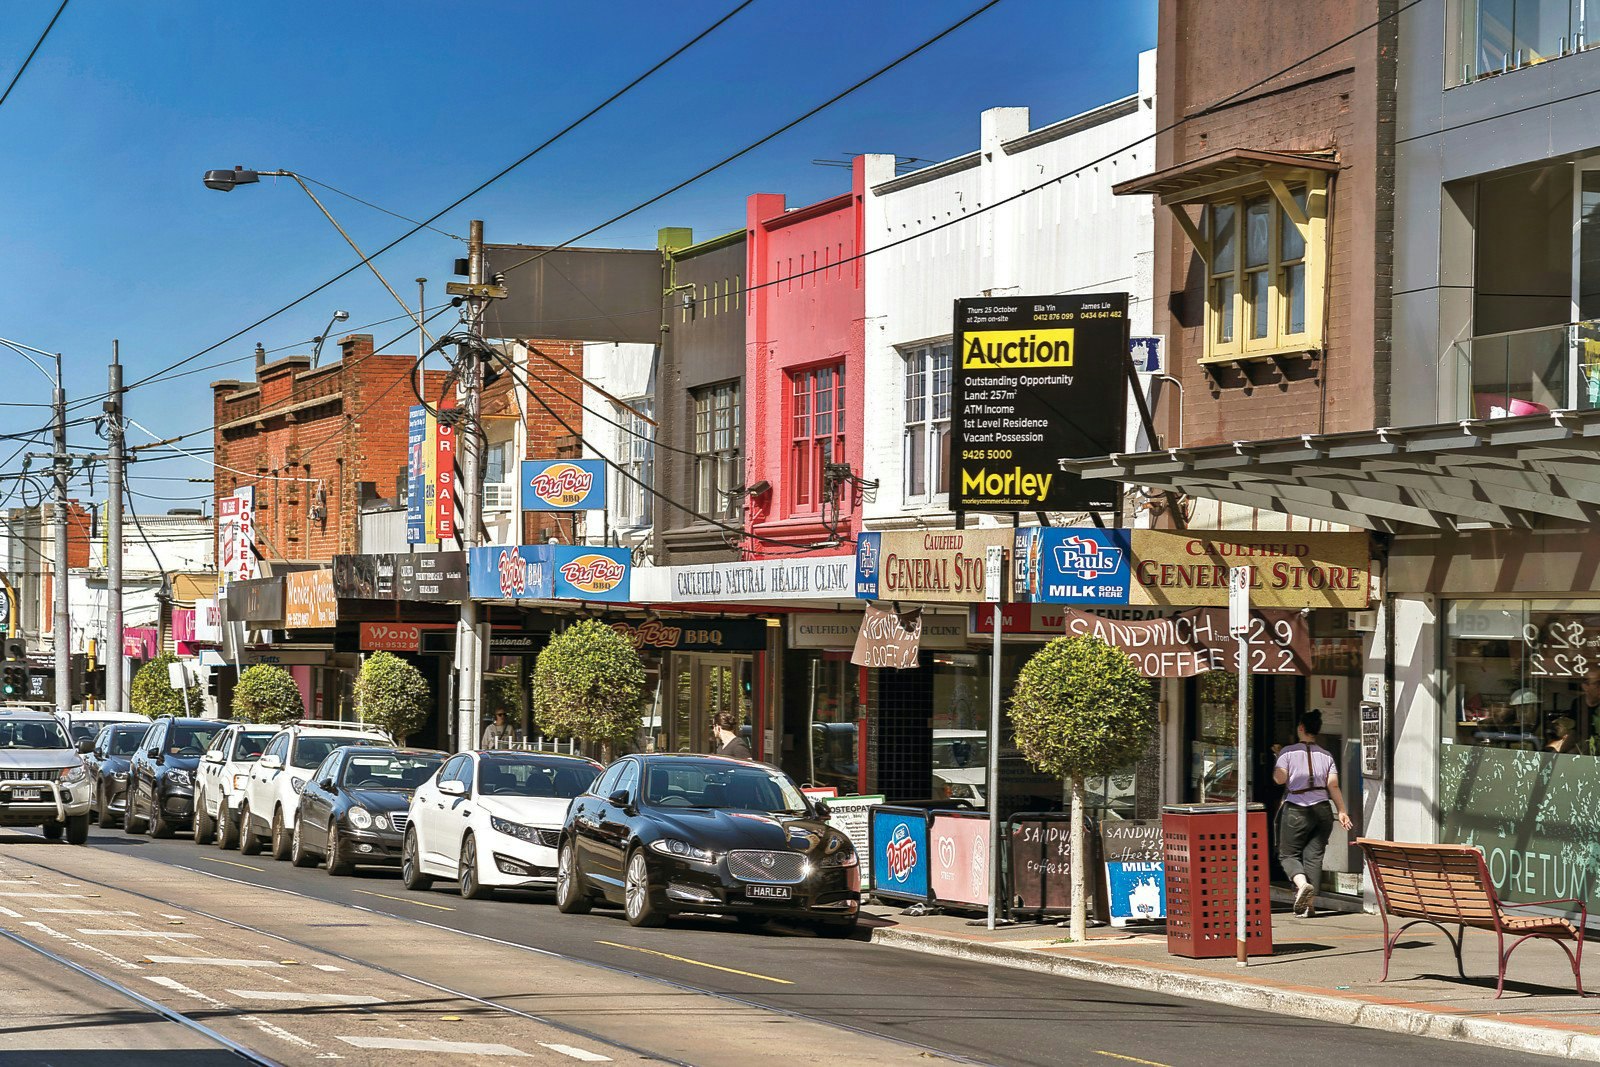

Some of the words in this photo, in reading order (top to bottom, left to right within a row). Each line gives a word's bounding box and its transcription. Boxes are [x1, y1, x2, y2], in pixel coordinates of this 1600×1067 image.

[966, 335, 1070, 364] Auction
[964, 376, 1017, 387] Outstanding
[1020, 374, 1074, 387] Opportunity
[964, 390, 988, 400] Land:
[964, 405, 982, 414] ATM
[984, 405, 1014, 414] Income
[963, 419, 975, 428] 1st
[977, 418, 1001, 428] Level
[1003, 418, 1048, 427] Residence
[963, 433, 994, 442] Vacant
[996, 432, 1044, 442] Possession
[962, 450, 985, 460] 9426
[987, 450, 1012, 459] 5000
[531, 474, 562, 500] Big
[558, 468, 593, 492] Boy
[962, 466, 1053, 502] Morley
[440, 473, 451, 531] SALE
[563, 494, 580, 503] BBQ
[241, 500, 249, 533] FOR
[924, 534, 963, 550] CAULFIELD
[1016, 536, 1027, 547] REAL
[1185, 540, 1309, 557] CAULFIELD
[1063, 550, 1113, 569] Pauls
[528, 563, 543, 588] BBQ
[560, 562, 594, 585] Big
[590, 558, 625, 580] Boy
[886, 554, 950, 591] GENERAL
[955, 553, 986, 591] STO
[1015, 560, 1026, 579] ICE
[1136, 560, 1264, 590] GENERL
[1271, 562, 1360, 590] STORE
[593, 582, 611, 590] BBQ
[677, 570, 721, 596] CAULFIELD
[725, 566, 766, 594] NATURAL
[771, 565, 809, 592] HEALTH
[814, 564, 848, 591] CLINIC
[858, 583, 869, 592] MILK
[1049, 585, 1096, 597] MILK
[985, 616, 1012, 626] AM
[1085, 608, 1162, 621] ENERAL
[642, 620, 680, 647] Boy
[685, 629, 723, 646] BBQ
[800, 626, 848, 635] CAULFIELD
[931, 626, 960, 635] CLINIC
[1070, 615, 1212, 647] SANDWICH
[1214, 630, 1229, 642] from
[1231, 617, 1292, 647] 2.9
[1128, 647, 1225, 677] COFFEE
[887, 838, 917, 880] Peters
[1122, 862, 1163, 872] MILK
[1480, 846, 1588, 902] ORETUM
[754, 887, 787, 897] HARLEA
